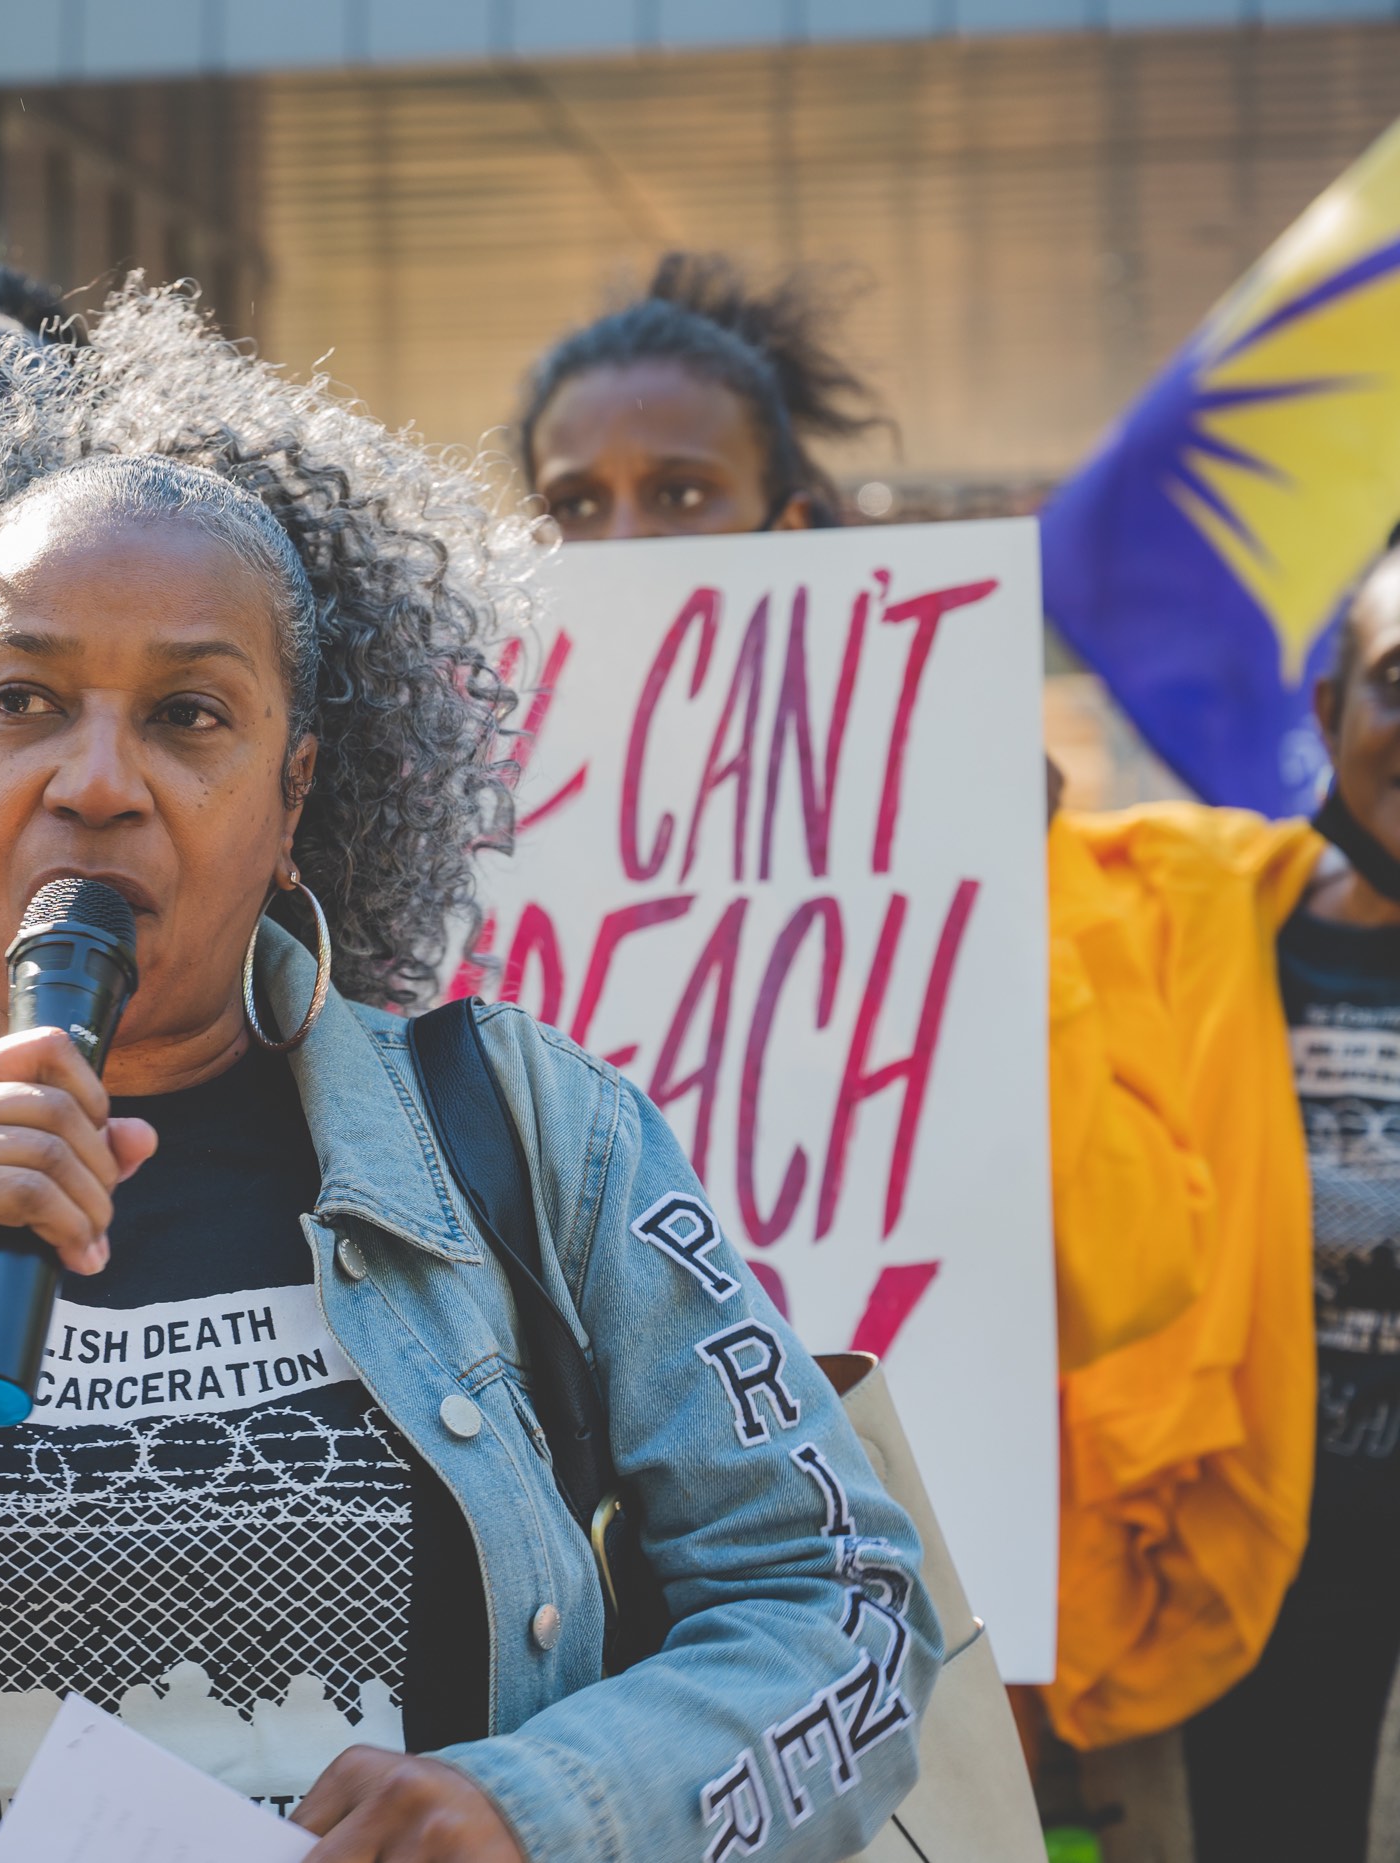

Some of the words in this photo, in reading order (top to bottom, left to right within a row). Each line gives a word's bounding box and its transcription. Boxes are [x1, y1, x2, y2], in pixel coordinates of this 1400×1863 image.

[618, 567, 1002, 888] CAN'T
[44, 1324, 129, 1365] ISH
[144, 1306, 277, 1360] DEATH
